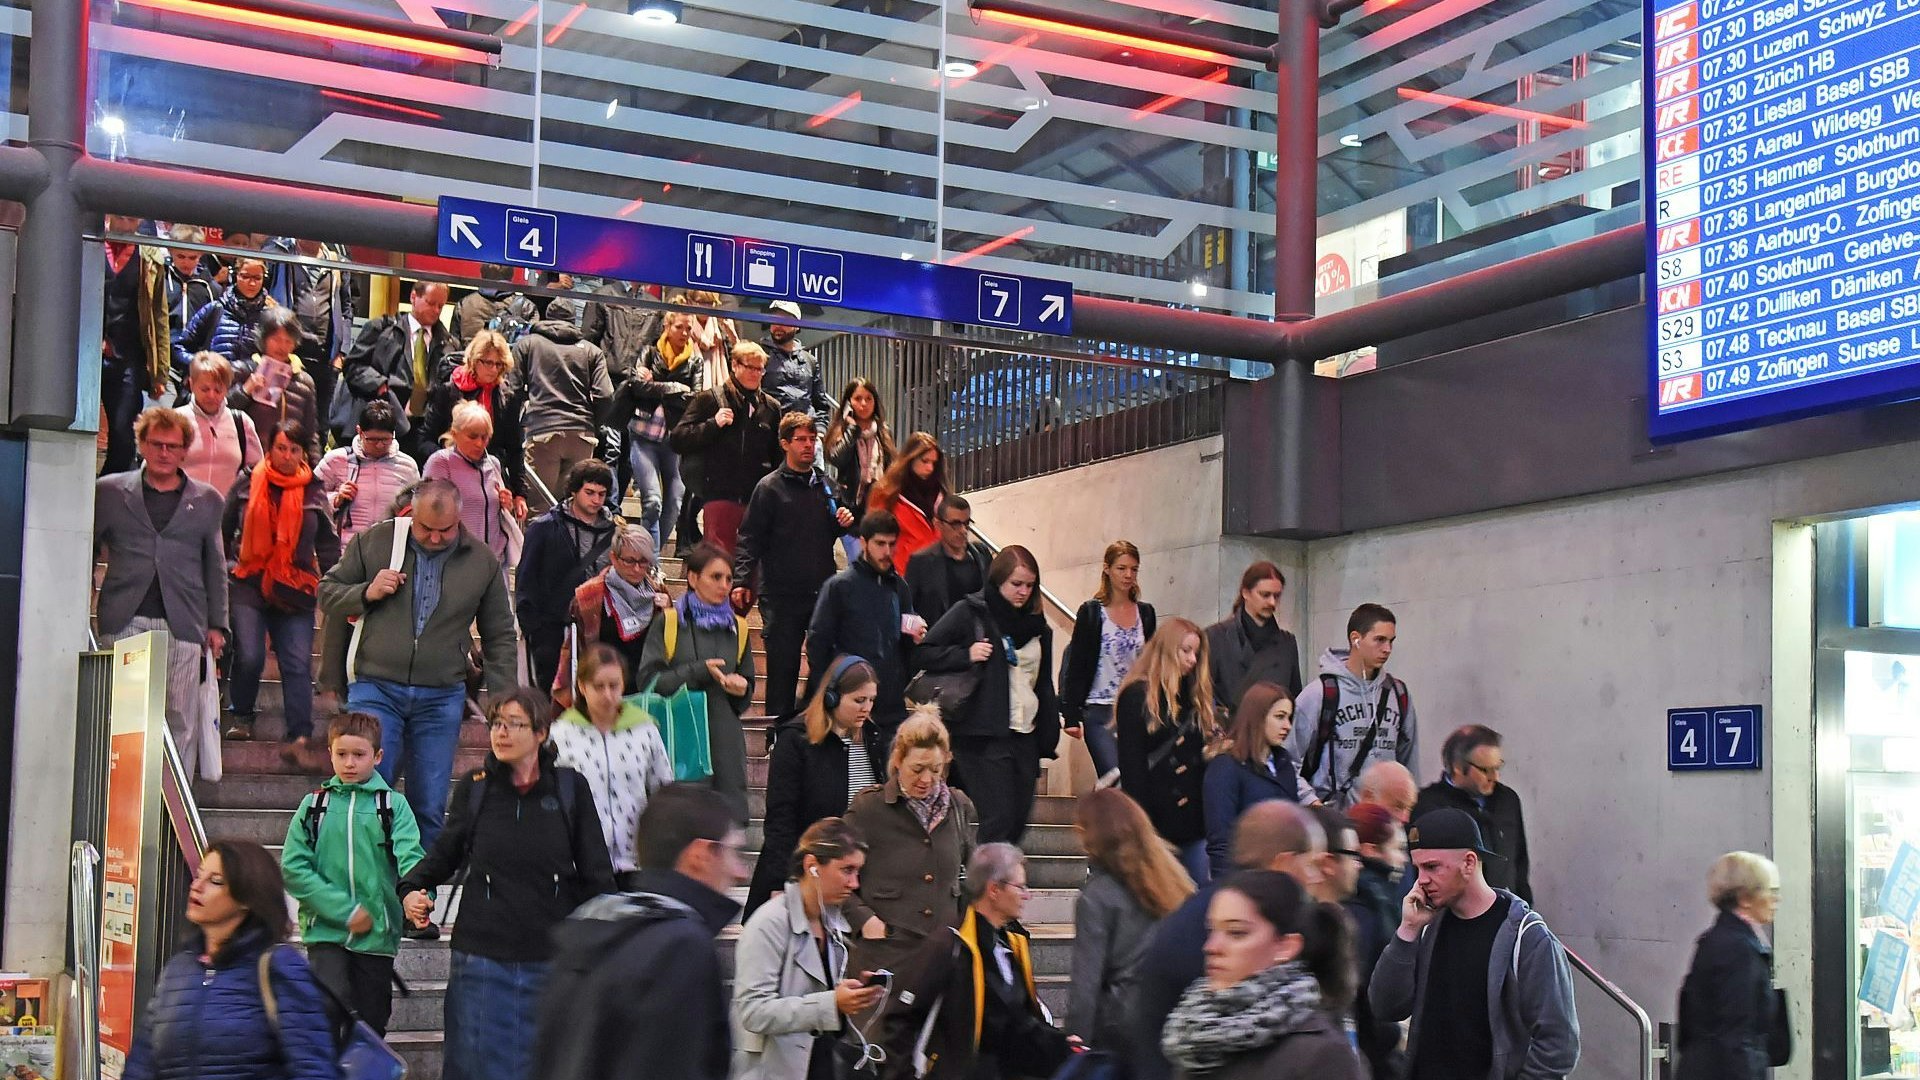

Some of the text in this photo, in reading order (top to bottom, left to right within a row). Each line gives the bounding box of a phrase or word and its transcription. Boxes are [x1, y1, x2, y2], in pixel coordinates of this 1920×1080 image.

[1657, 7, 1690, 39] IC
[1657, 0, 1798, 70] IR 07.30 Basel
[1657, 69, 1690, 101] IR
[1702, 49, 1747, 81] 07.30
[1753, 29, 1809, 63] Luzern
[1818, 1, 1886, 39] Schwyz
[1657, 49, 1835, 131] IR 07.30 Zürich HB
[1657, 57, 1910, 160] ICE 07.32 Liestal Basel SBB
[1659, 89, 1920, 190] RE 07.35 Aarau Wildegg We
[1659, 126, 1919, 220] R 07.35 Hammer Solothurn
[512, 215, 530, 225] Gleis
[1659, 159, 1920, 254] IR 07.36 Langenthal Burgdo
[519, 227, 543, 258] 4
[749, 248, 776, 258] Shopping
[1660, 258, 1682, 280] S8
[1704, 238, 1749, 267] 07.36
[1754, 213, 1846, 255] Aarburg-O.
[801, 272, 839, 296] WC
[991, 289, 1009, 318] 7
[1659, 284, 1691, 313] ICN
[1705, 269, 1749, 298] 07.40
[1755, 252, 1834, 286] Solothurn
[1661, 316, 1694, 341] S29
[1705, 301, 1750, 329] 07.42
[1756, 288, 1821, 317] Dulliken
[1831, 267, 1903, 300] Däniken
[1661, 293, 1920, 371] S3 07.48 Tecknau Basel SB
[1660, 376, 1694, 405] IR
[1706, 364, 1751, 392] 07.49
[1756, 351, 1829, 382] Zofingen
[1838, 336, 1901, 364] Sursee
[1680, 728, 1698, 758] 4
[1725, 726, 1742, 758] 7
